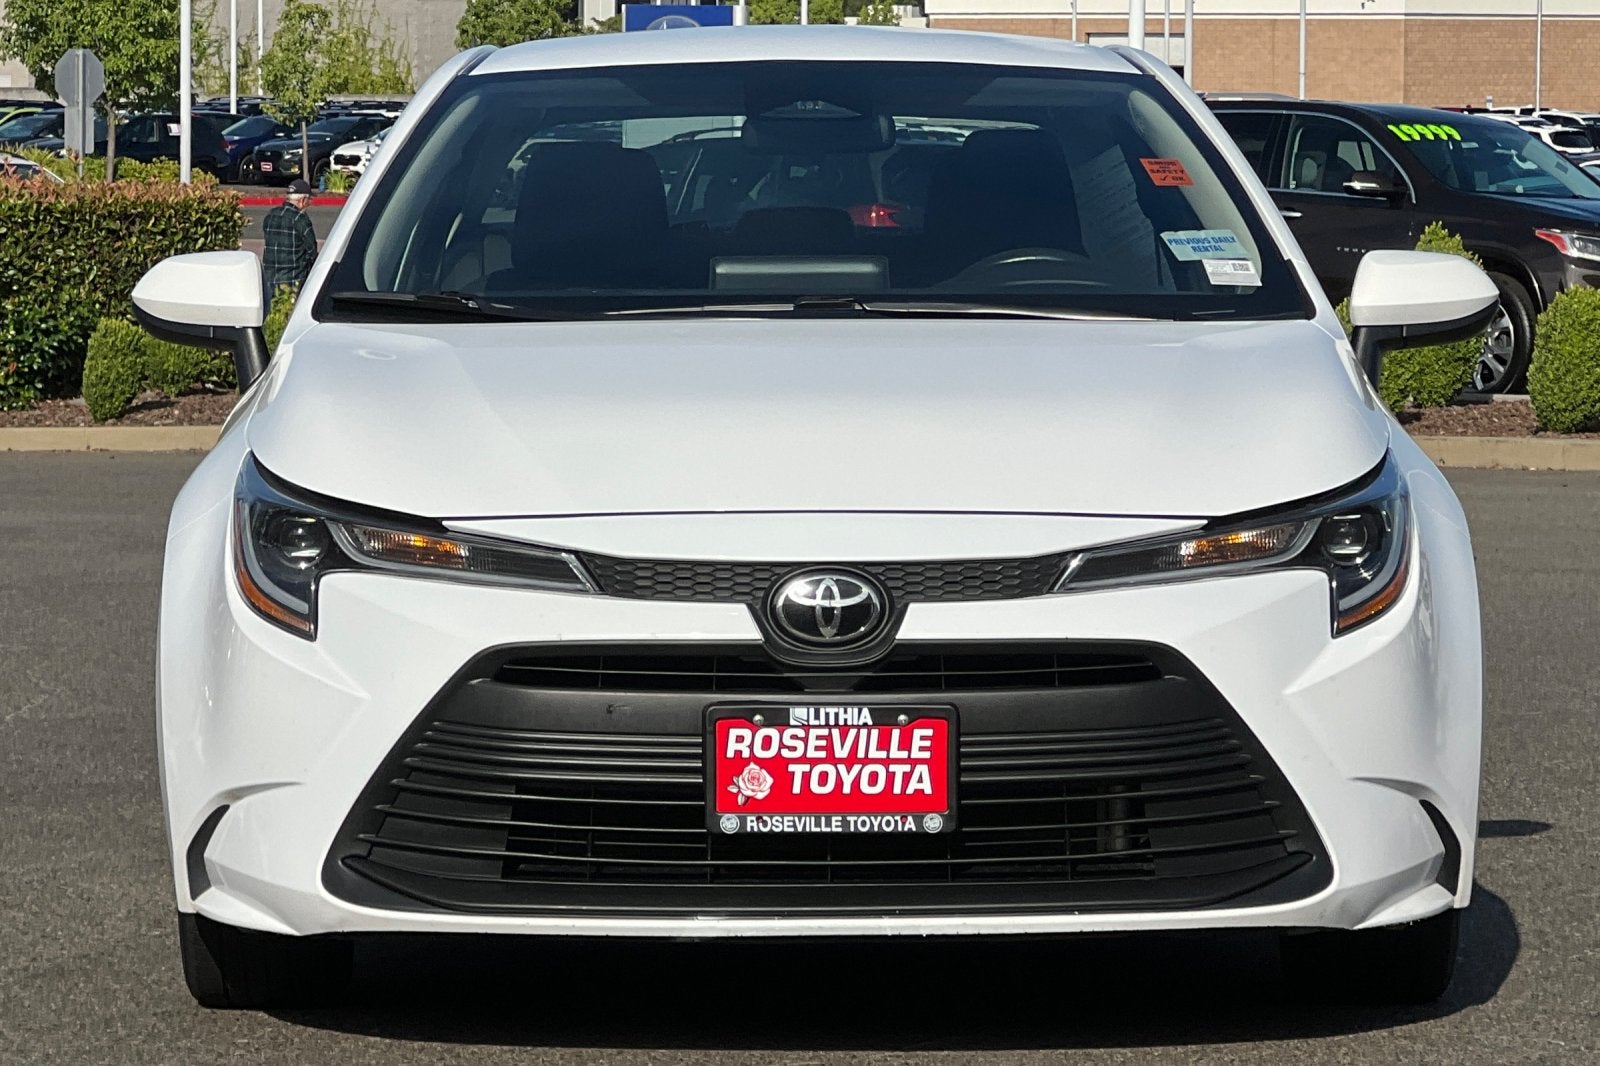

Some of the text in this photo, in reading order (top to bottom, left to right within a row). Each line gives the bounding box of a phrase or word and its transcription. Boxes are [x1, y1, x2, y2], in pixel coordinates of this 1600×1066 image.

[1387, 123, 1461, 141] 19999
[1167, 236, 1237, 246] PREVIOUS DAILY
[1191, 244, 1226, 253] RENTAL
[808, 707, 873, 726] LITHIA
[726, 728, 934, 759] ROSEVILLE
[788, 764, 933, 795] TOYOTA
[746, 816, 916, 832] ROSEVILLE TOYOTA
